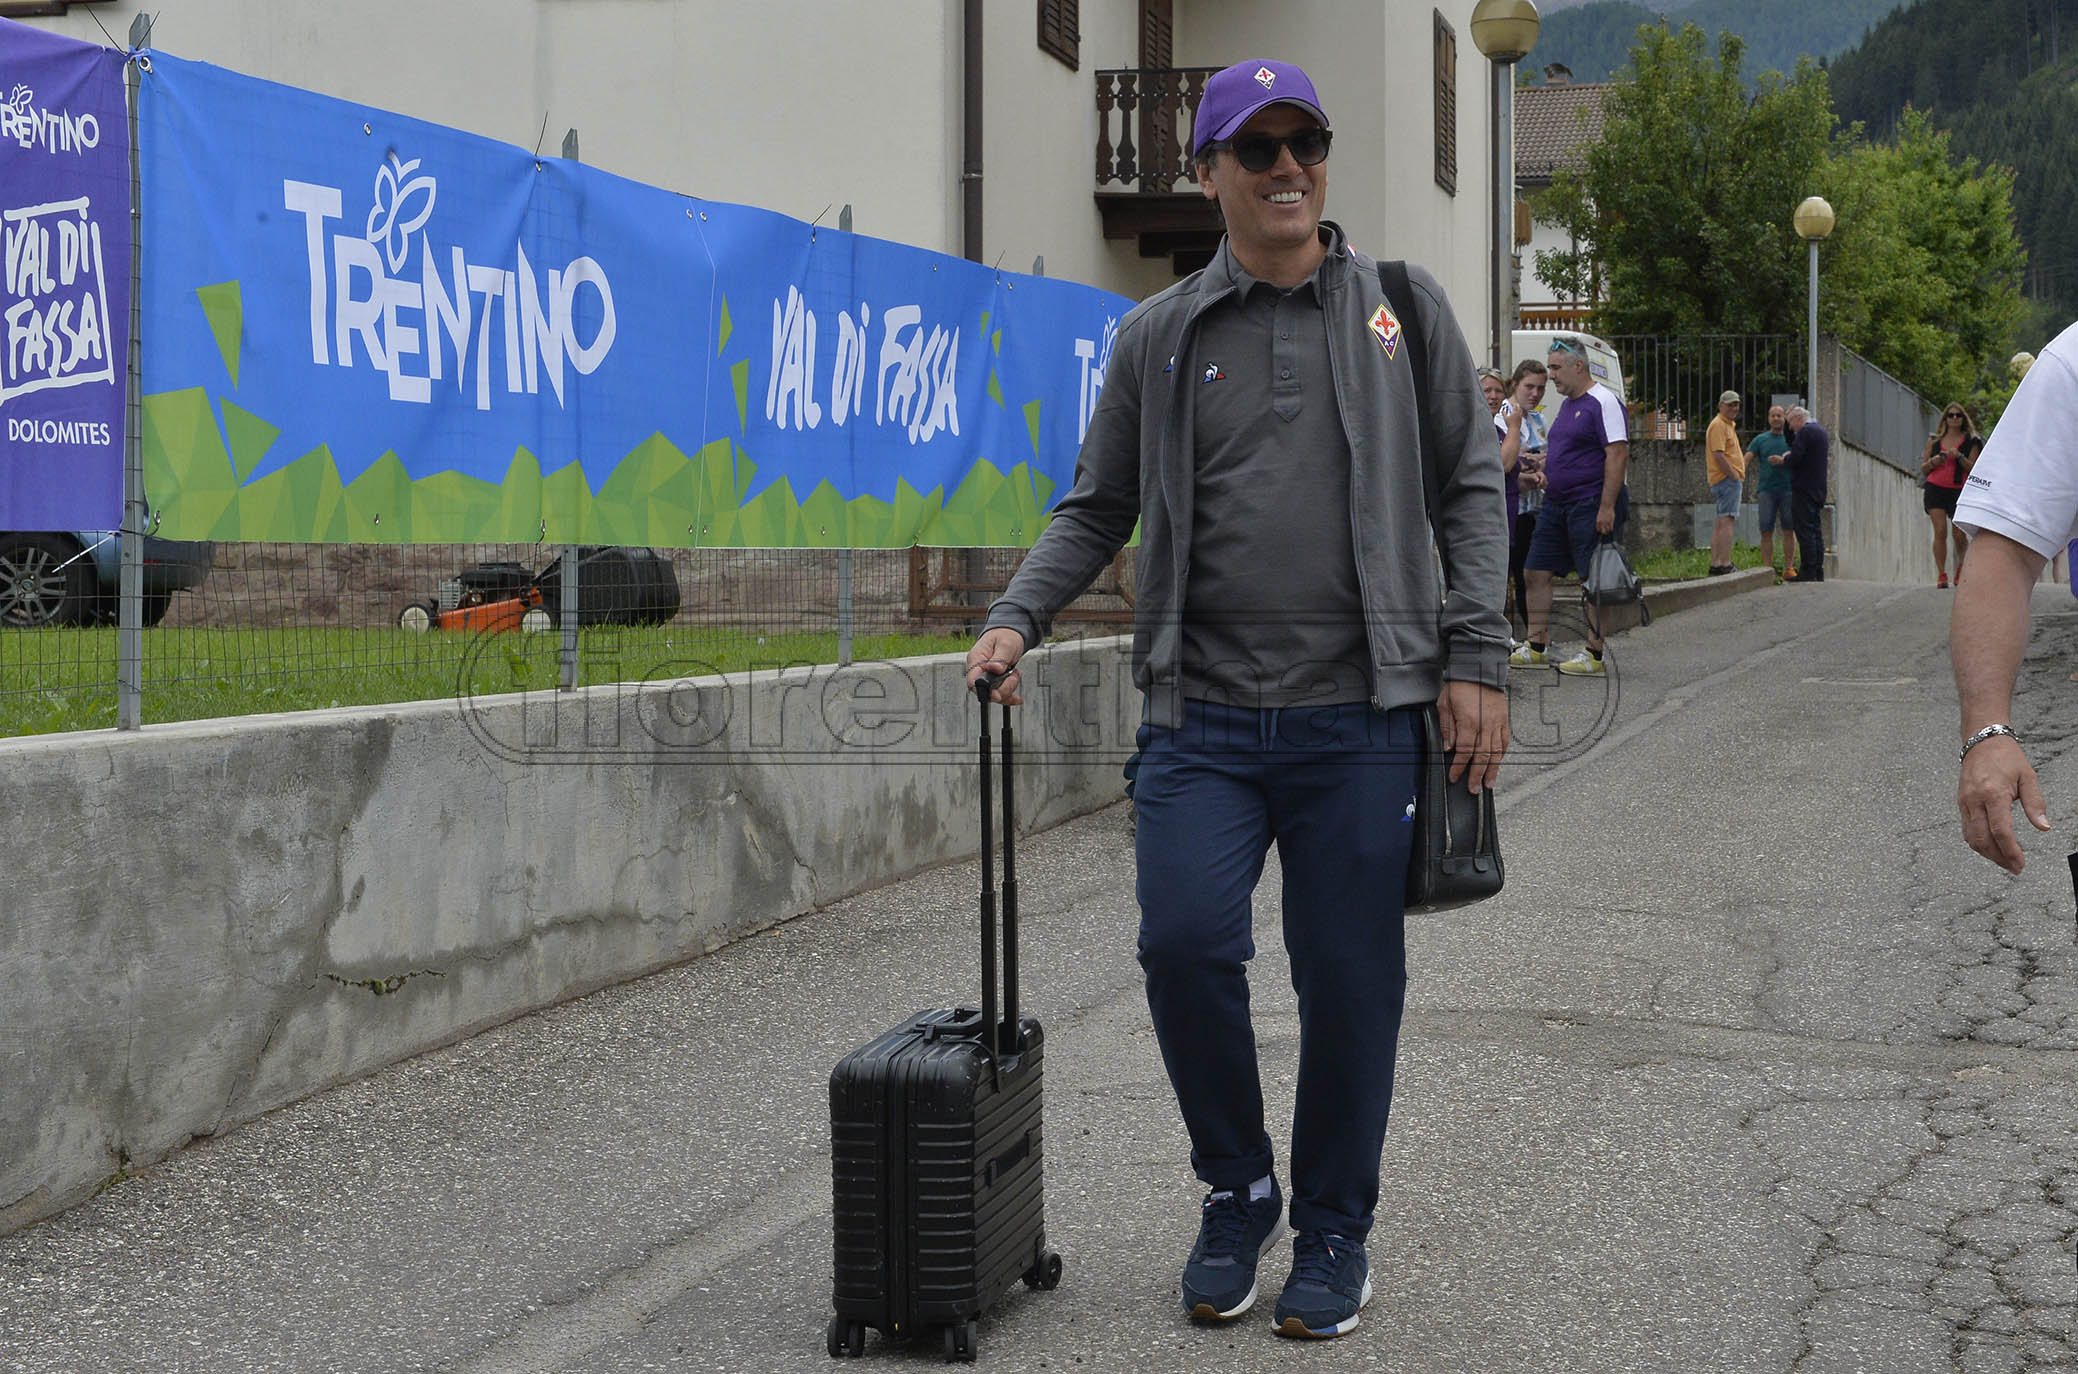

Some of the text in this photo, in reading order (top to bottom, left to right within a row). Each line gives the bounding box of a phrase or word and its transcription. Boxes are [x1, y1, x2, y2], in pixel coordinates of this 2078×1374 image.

[0, 91, 100, 157] RENTINO
[5, 216, 56, 298] VAL
[284, 179, 617, 410] TRENTINO
[4, 292, 103, 381] FASSA
[766, 284, 822, 432] VAL
[876, 304, 960, 445] FASSA
[8, 418, 111, 446] DOLOMITES
